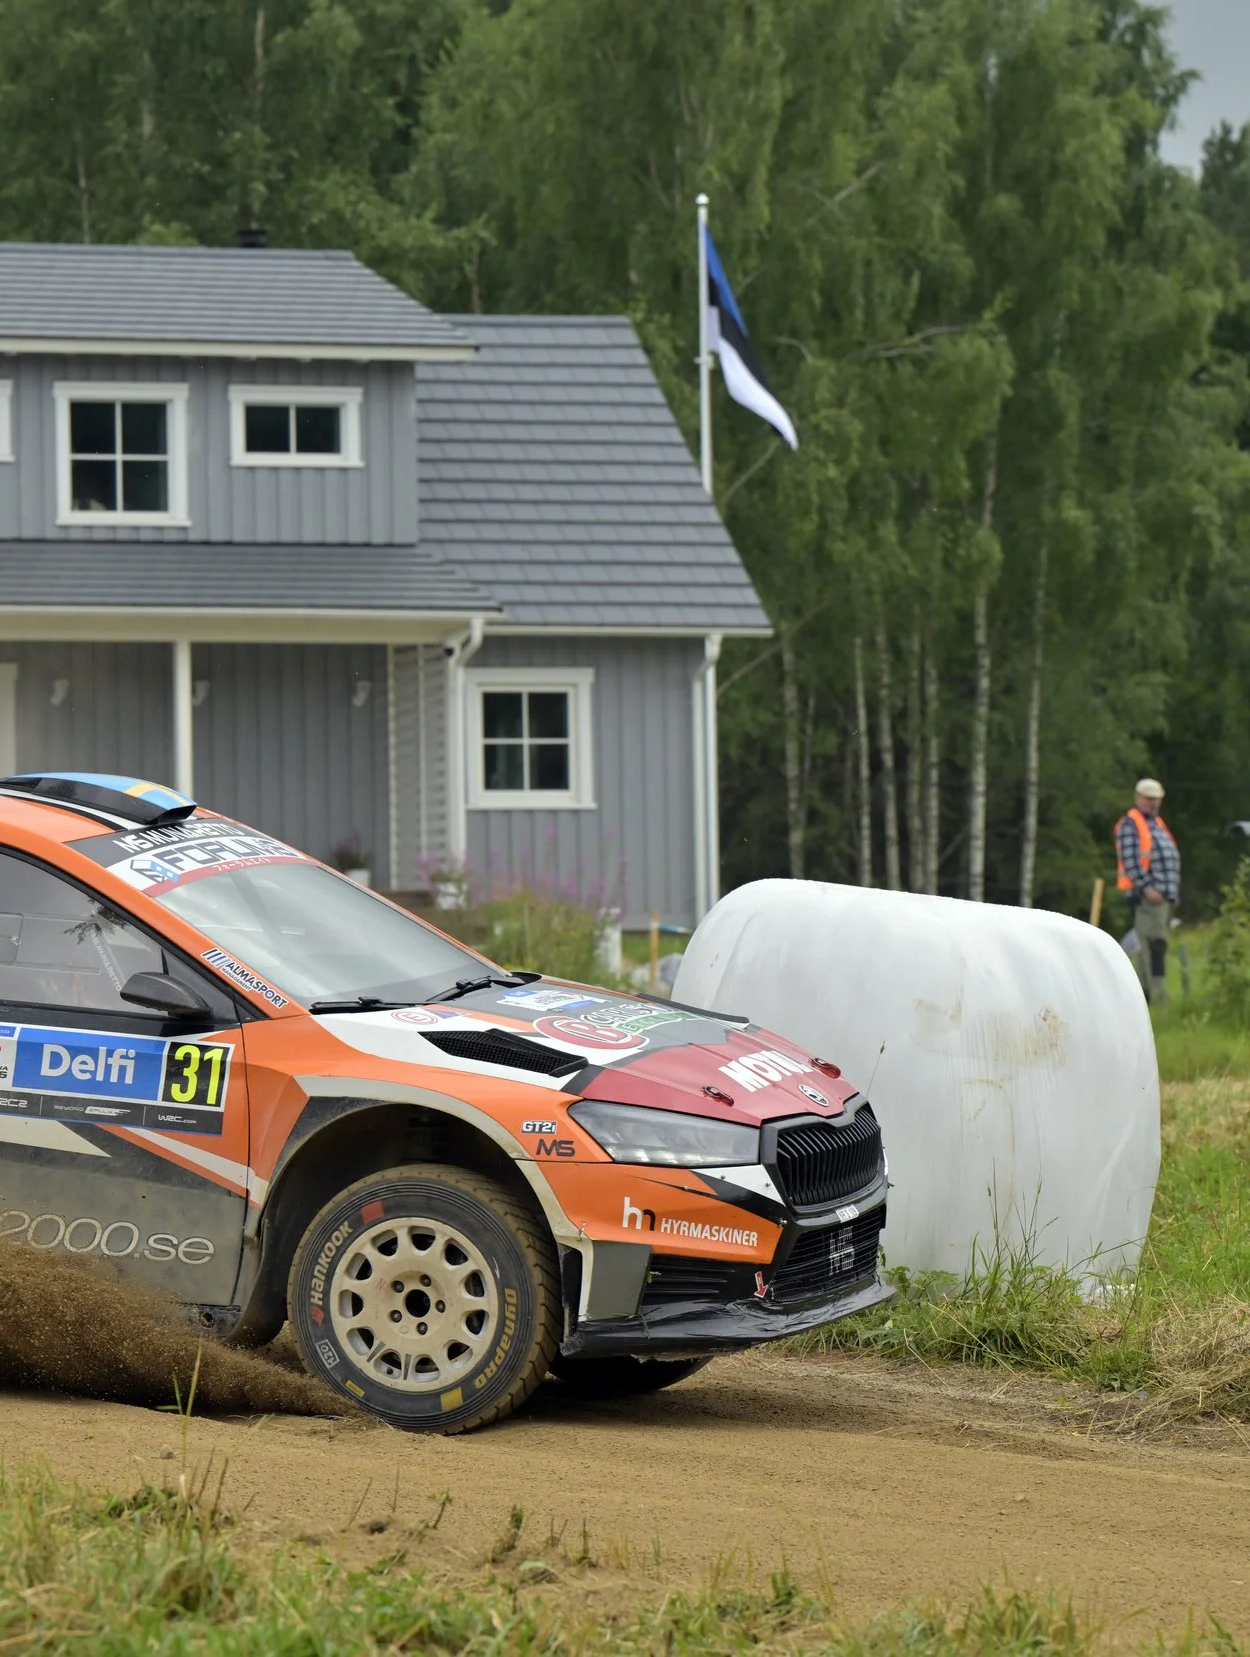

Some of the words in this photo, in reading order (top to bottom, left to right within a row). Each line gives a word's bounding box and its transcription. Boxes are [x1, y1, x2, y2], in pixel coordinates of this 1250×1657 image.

[222, 967, 252, 991] MANAGEMENT
[226, 962, 287, 1008] ALMASPORT
[40, 1044, 136, 1084] Delfi
[171, 1044, 224, 1105] 31
[718, 1050, 813, 1092] MOTUL
[522, 1121, 556, 1133] GT2i
[536, 1139, 575, 1157] MS
[661, 1218, 758, 1247] HYRMASKINER
